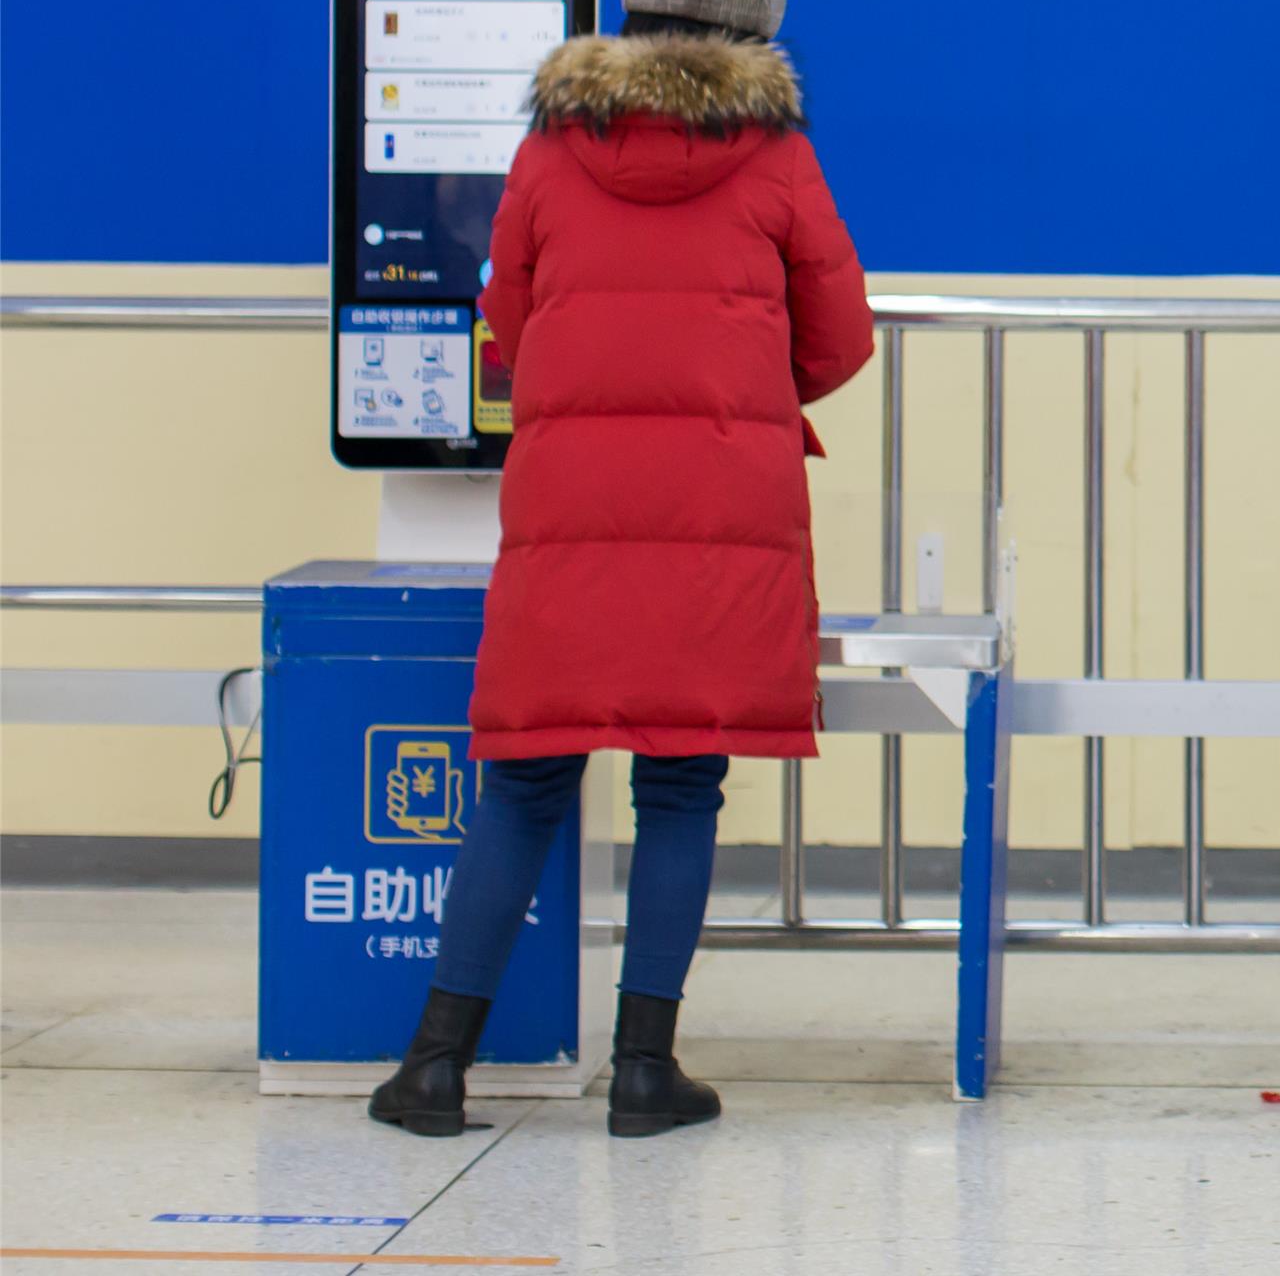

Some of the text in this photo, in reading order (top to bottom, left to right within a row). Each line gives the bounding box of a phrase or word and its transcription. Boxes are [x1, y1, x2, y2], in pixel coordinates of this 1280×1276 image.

[304, 866, 540, 925] 自助
[366, 936, 440, 959] （手机支
